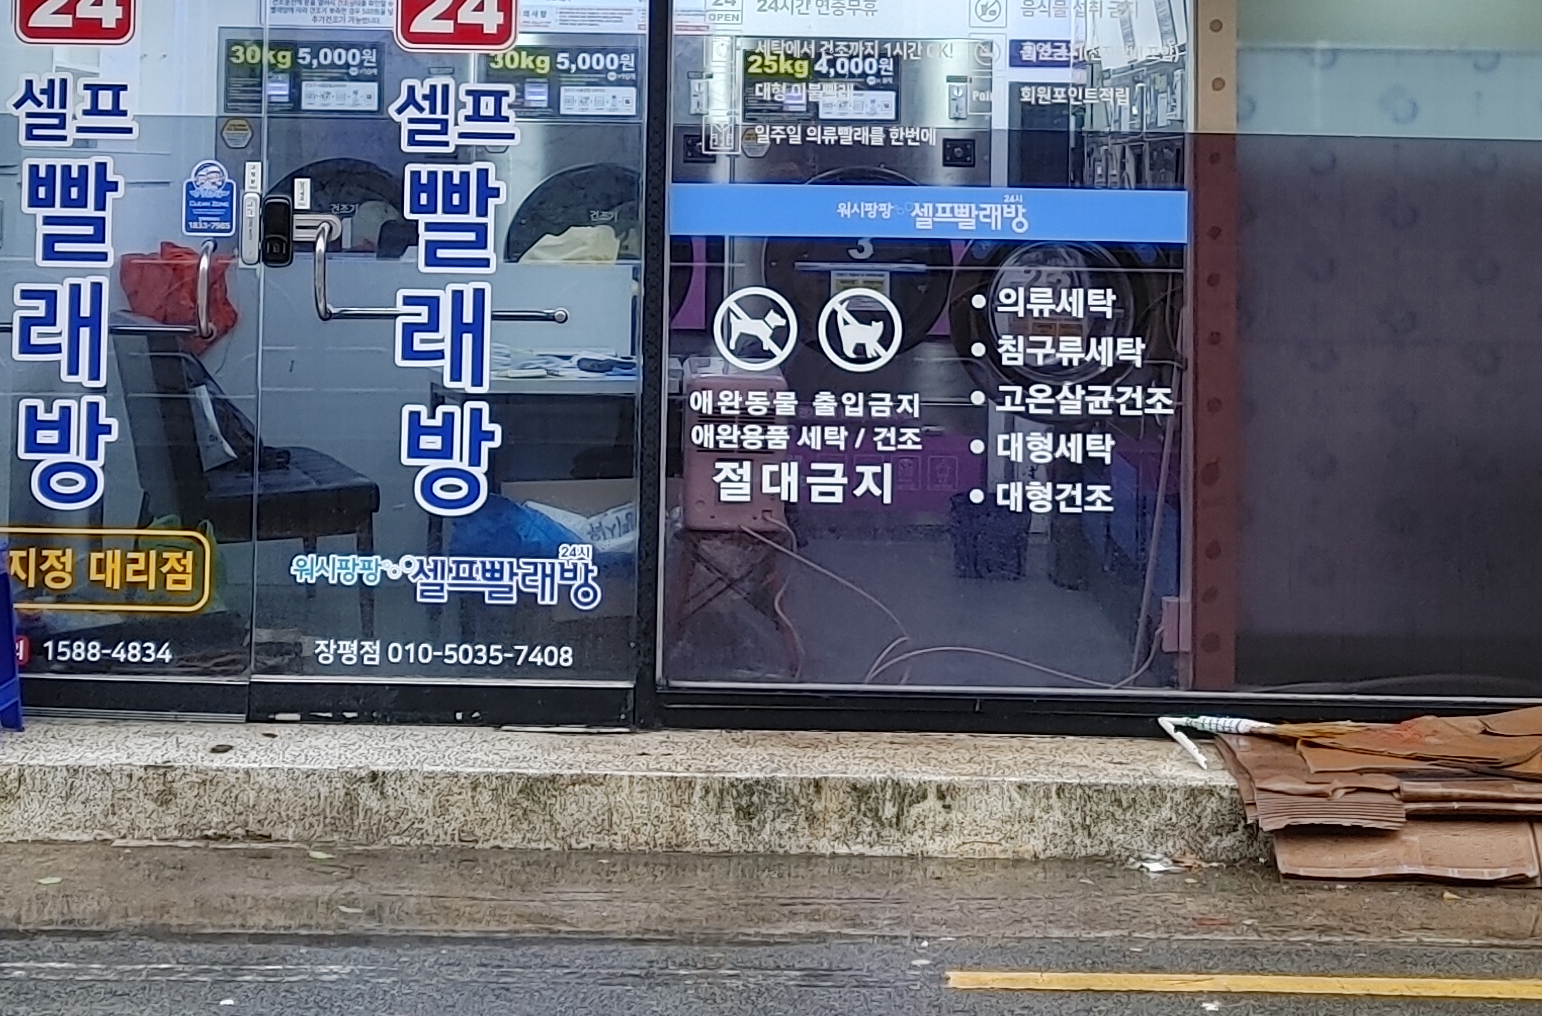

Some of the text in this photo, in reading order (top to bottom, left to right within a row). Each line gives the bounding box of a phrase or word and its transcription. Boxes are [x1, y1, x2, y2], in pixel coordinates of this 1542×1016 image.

[708, 13, 740, 23] OPEN
[230, 44, 378, 69] 30kg 5,000원
[489, 50, 636, 74] 30kg 5,000원
[754, 40, 816, 59] 세탁에서
[819, 41, 880, 60] 건조까지
[884, 42, 924, 60] 1시간
[747, 55, 895, 78] 25kg 4,000원
[754, 82, 786, 102] 대형
[1019, 86, 1131, 105] 회원포인트적립
[9, 73, 140, 148] 셀프
[389, 77, 521, 155] 셀프
[753, 124, 937, 147] 일주일 의류빨래를 한번에
[836, 200, 1029, 234] 워시팡팡 셀프빨래방
[996, 286, 1117, 319] 의류세탁
[996, 334, 1146, 368] 침구류세탁
[689, 389, 922, 418] 애완동물 출입금지
[995, 383, 1175, 417] 고온살균건조
[690, 423, 790, 452] 애완용품
[796, 423, 848, 452] 세탁
[872, 425, 924, 453] 건조
[996, 432, 1116, 465] 대형세탁
[711, 459, 894, 505] 절대금지
[996, 481, 1115, 514] 대형건조
[558, 544, 592, 561] 24시
[9, 546, 195, 593] 지정 대리점
[290, 554, 602, 611] 워시팡팡 셀프빨래방
[42, 639, 173, 665] 1588-4834
[314, 639, 574, 667] 장평점 010-5035-7408
